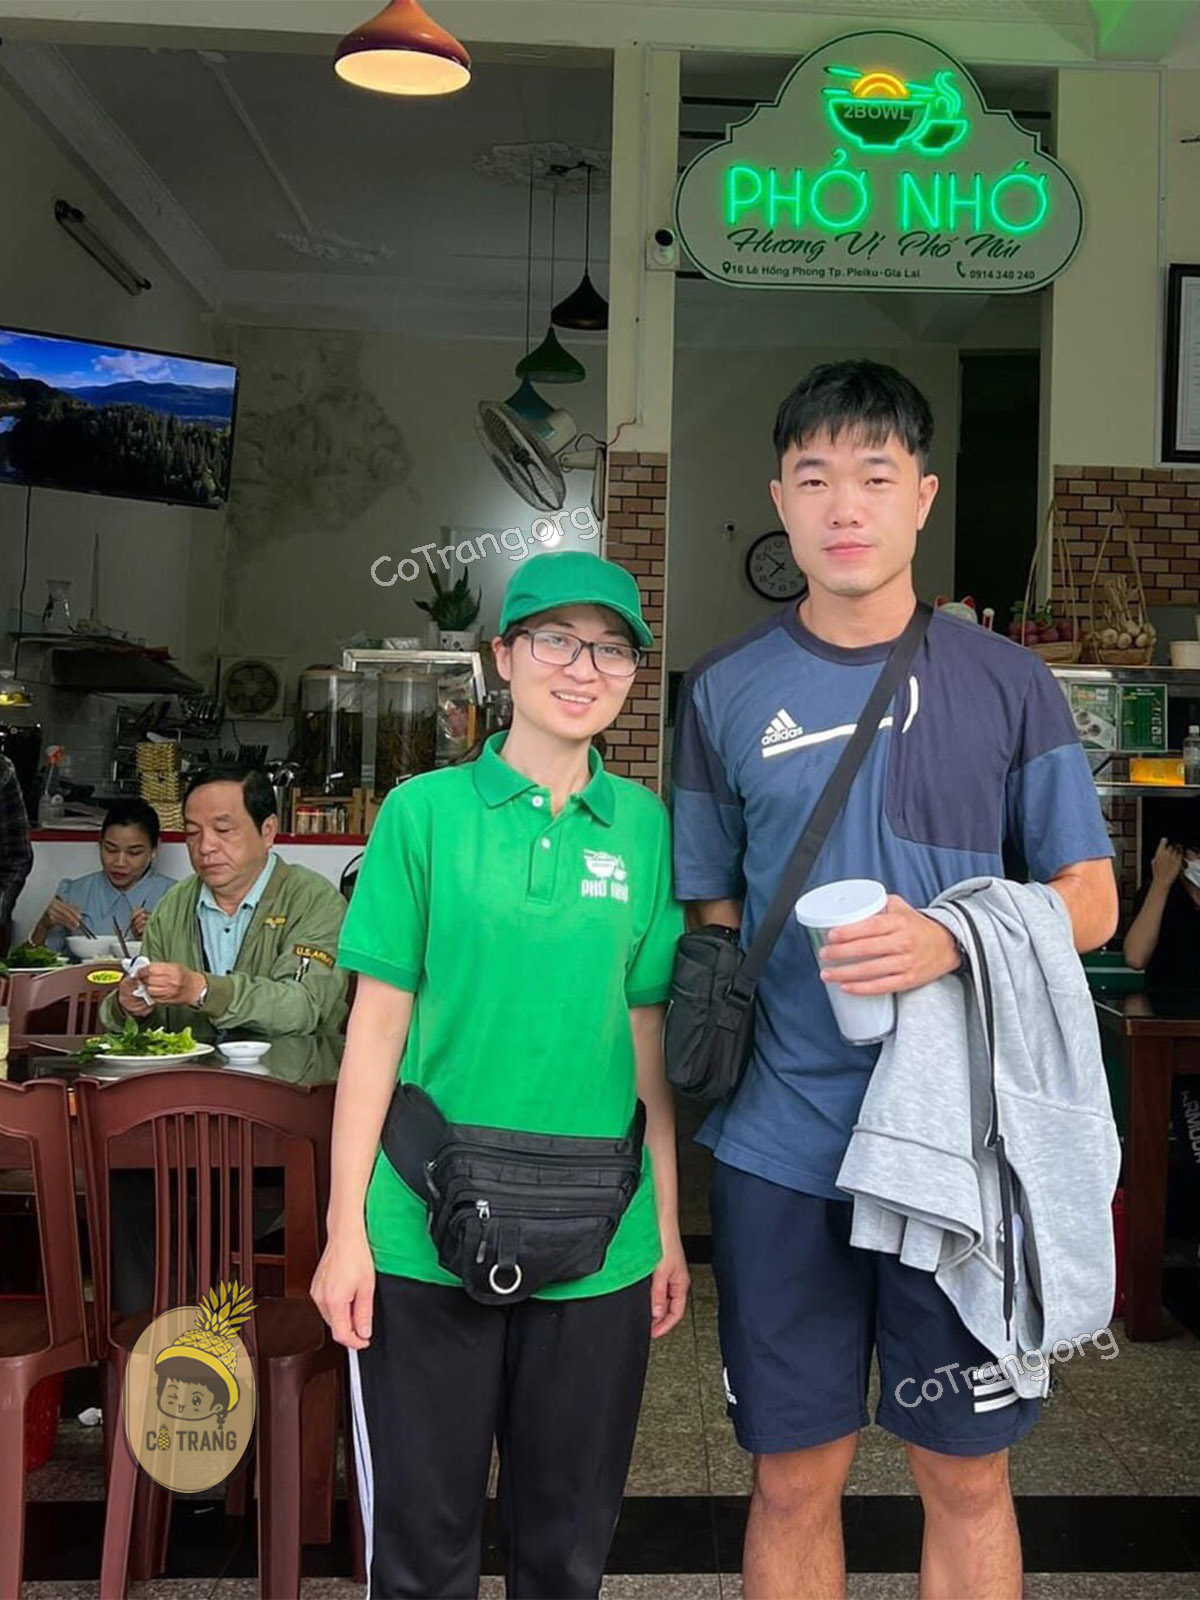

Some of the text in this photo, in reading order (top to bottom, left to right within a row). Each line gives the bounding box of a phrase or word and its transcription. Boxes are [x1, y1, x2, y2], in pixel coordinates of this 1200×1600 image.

[843, 104, 911, 120] 2BOWL
[727, 148, 1048, 231] PHỞ NHỚ
[834, 231, 887, 260] Vị
[965, 233, 1021, 258] Núi
[732, 265, 744, 275] 16
[792, 266, 825, 278] Phong
[904, 268, 920, 278] Lai
[970, 270, 994, 279] 0914
[1017, 270, 1035, 280] 240
[761, 726, 803, 745] adidas
